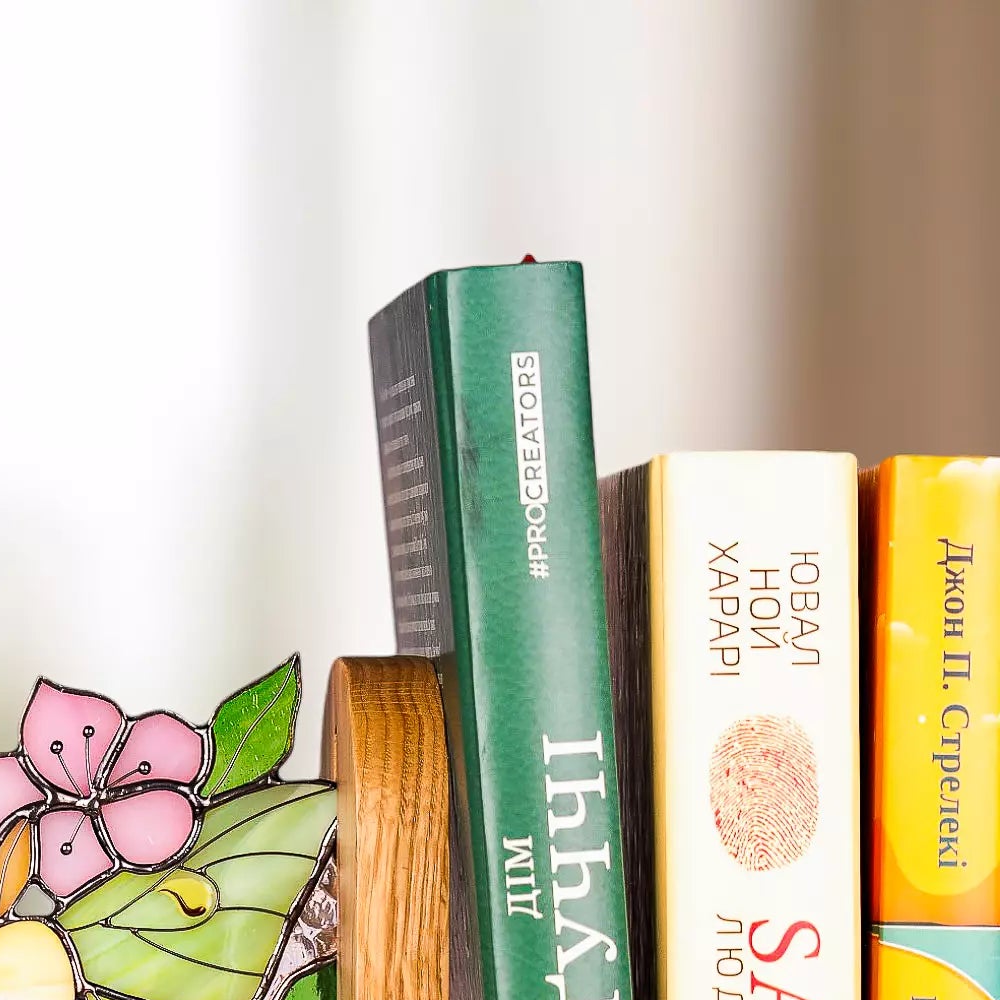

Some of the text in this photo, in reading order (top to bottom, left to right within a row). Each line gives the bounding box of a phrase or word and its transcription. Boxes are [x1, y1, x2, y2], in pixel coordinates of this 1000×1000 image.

[511, 351, 549, 579] #PROCREATORS
[708, 541, 741, 677] ХАРАРІ
[749, 568, 791, 650] НОЙ
[790, 550, 820, 666] ЮВАЛ
[931, 538, 974, 869] Джон П. Стрелекі
[502, 835, 542, 918] ДІМ
